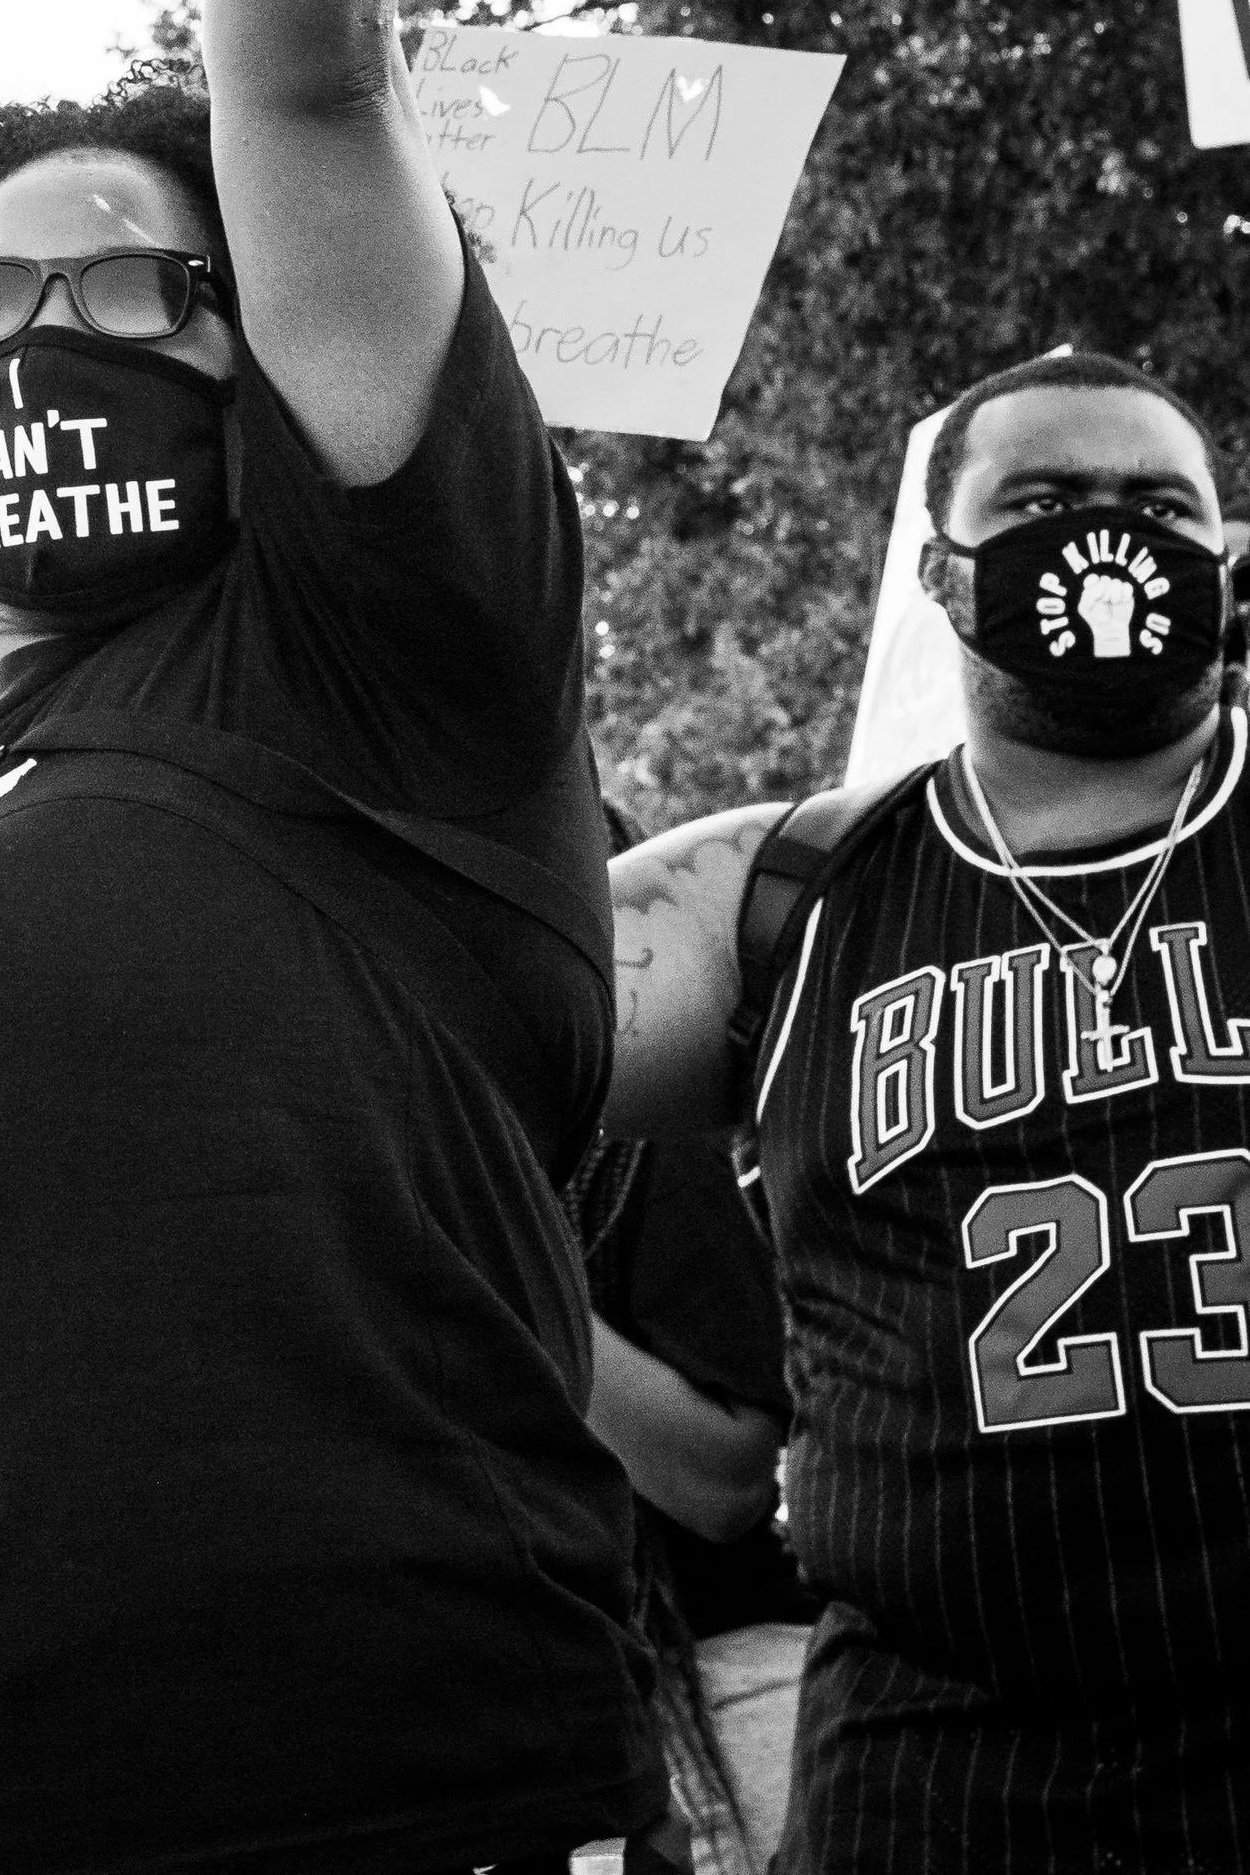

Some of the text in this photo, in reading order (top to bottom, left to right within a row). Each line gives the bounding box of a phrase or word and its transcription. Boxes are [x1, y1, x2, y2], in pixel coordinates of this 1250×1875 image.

[426, 118, 496, 151] tter
[527, 52, 724, 161] BLM
[511, 176, 640, 272] Killing
[510, 299, 705, 370] breathe
[8, 358, 24, 410] I
[1036, 529, 1172, 657] STOP KILLING US
[961, 1148, 1250, 1432] 23
